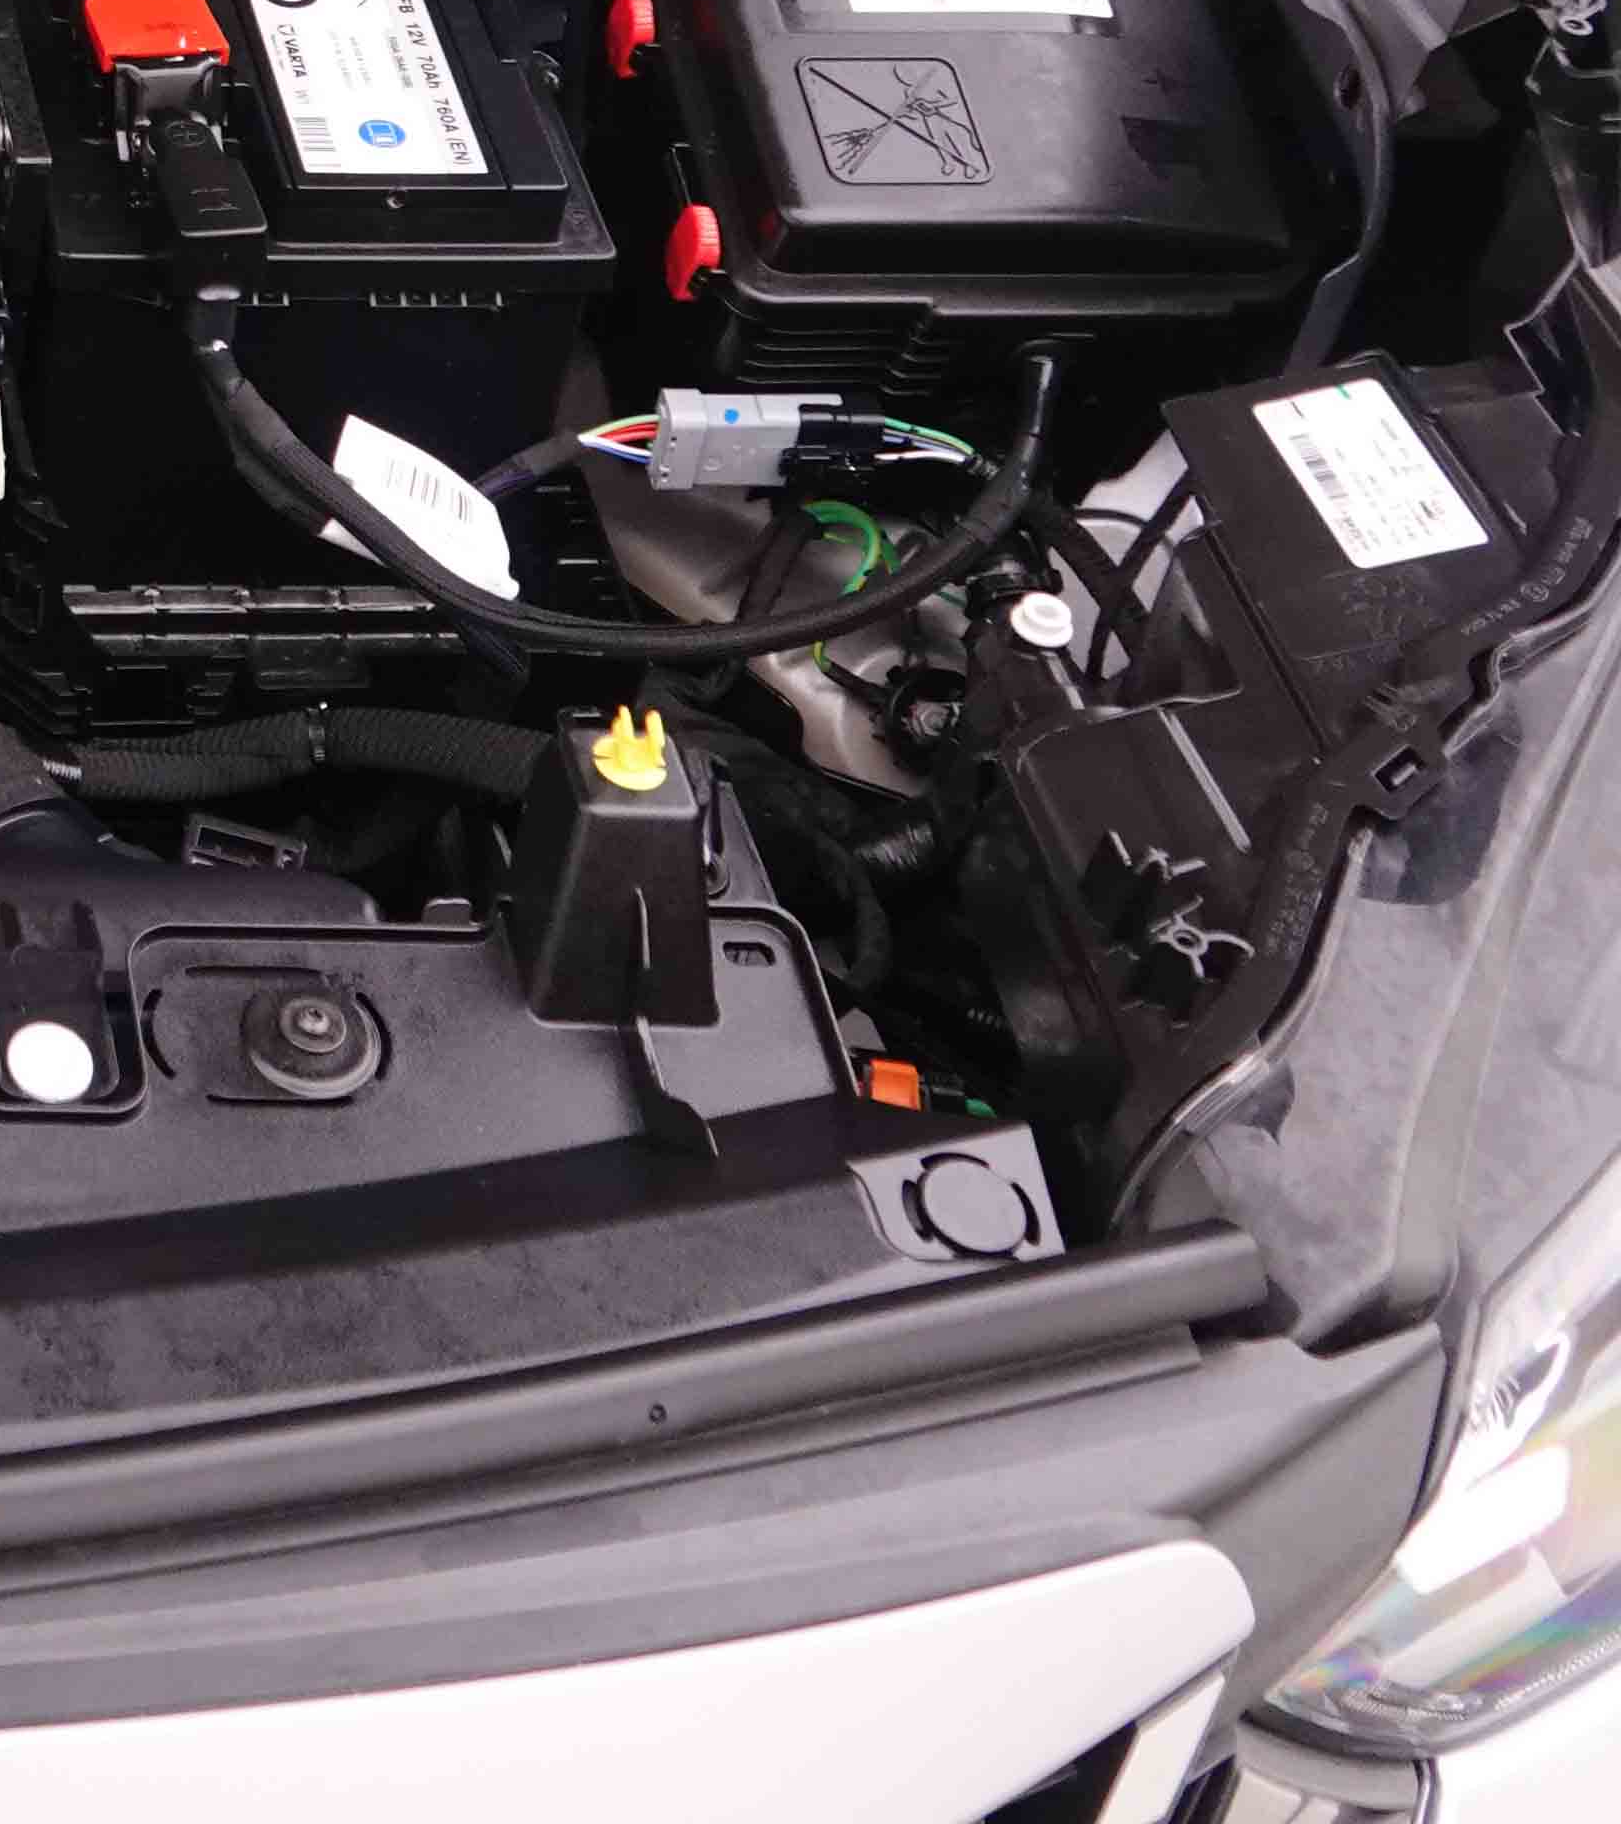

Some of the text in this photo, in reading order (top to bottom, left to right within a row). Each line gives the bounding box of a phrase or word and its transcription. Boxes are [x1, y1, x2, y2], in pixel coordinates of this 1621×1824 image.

[284, 37, 308, 78] VARTA
[404, 23, 428, 47] 12V
[416, 55, 441, 89] 70Ah
[433, 98, 459, 133] 760A
